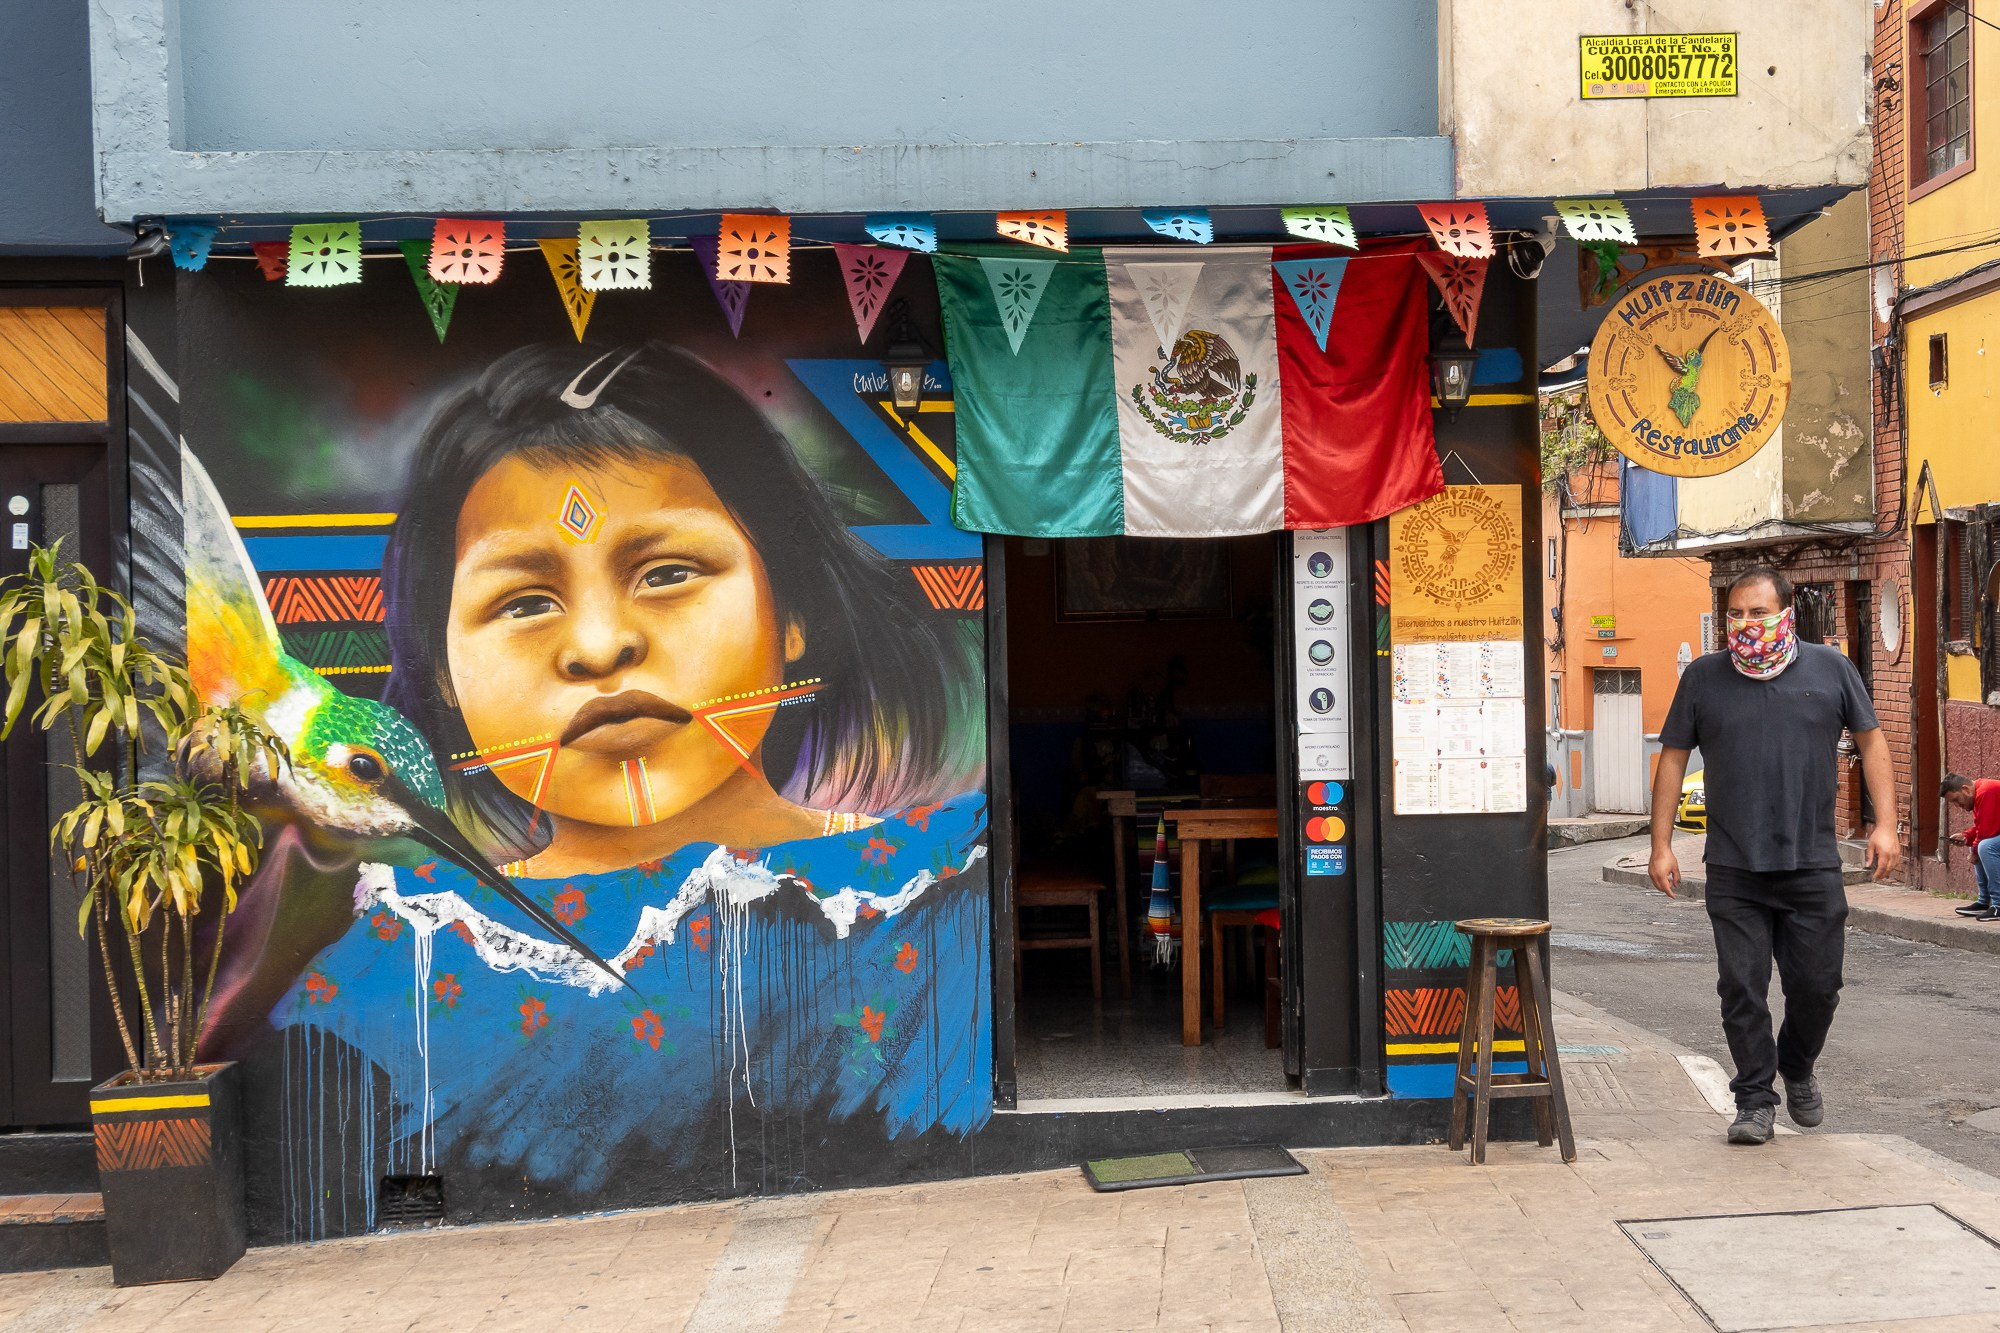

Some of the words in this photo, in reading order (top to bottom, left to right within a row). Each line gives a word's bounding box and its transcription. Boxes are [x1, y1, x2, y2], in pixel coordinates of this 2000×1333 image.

[1588, 44, 1686, 56] CUADRANTE
[1691, 44, 1716, 53] No.
[1721, 43, 1731, 53] 9
[1627, 37, 1652, 46] Local
[1655, 37, 1667, 45] de
[1669, 36, 1678, 44] la
[1681, 36, 1732, 44] Candelaria
[1585, 70, 1602, 80] Cel.
[1602, 53, 1733, 81] 3008057772
[1714, 86, 1732, 94] police
[1617, 278, 1741, 327] Huitzilin
[1631, 412, 1759, 456] Restaurante
[1423, 574, 1496, 599] Restaurante
[1397, 617, 1446, 628] Bienvenidos
[1453, 617, 1487, 627] nuestro
